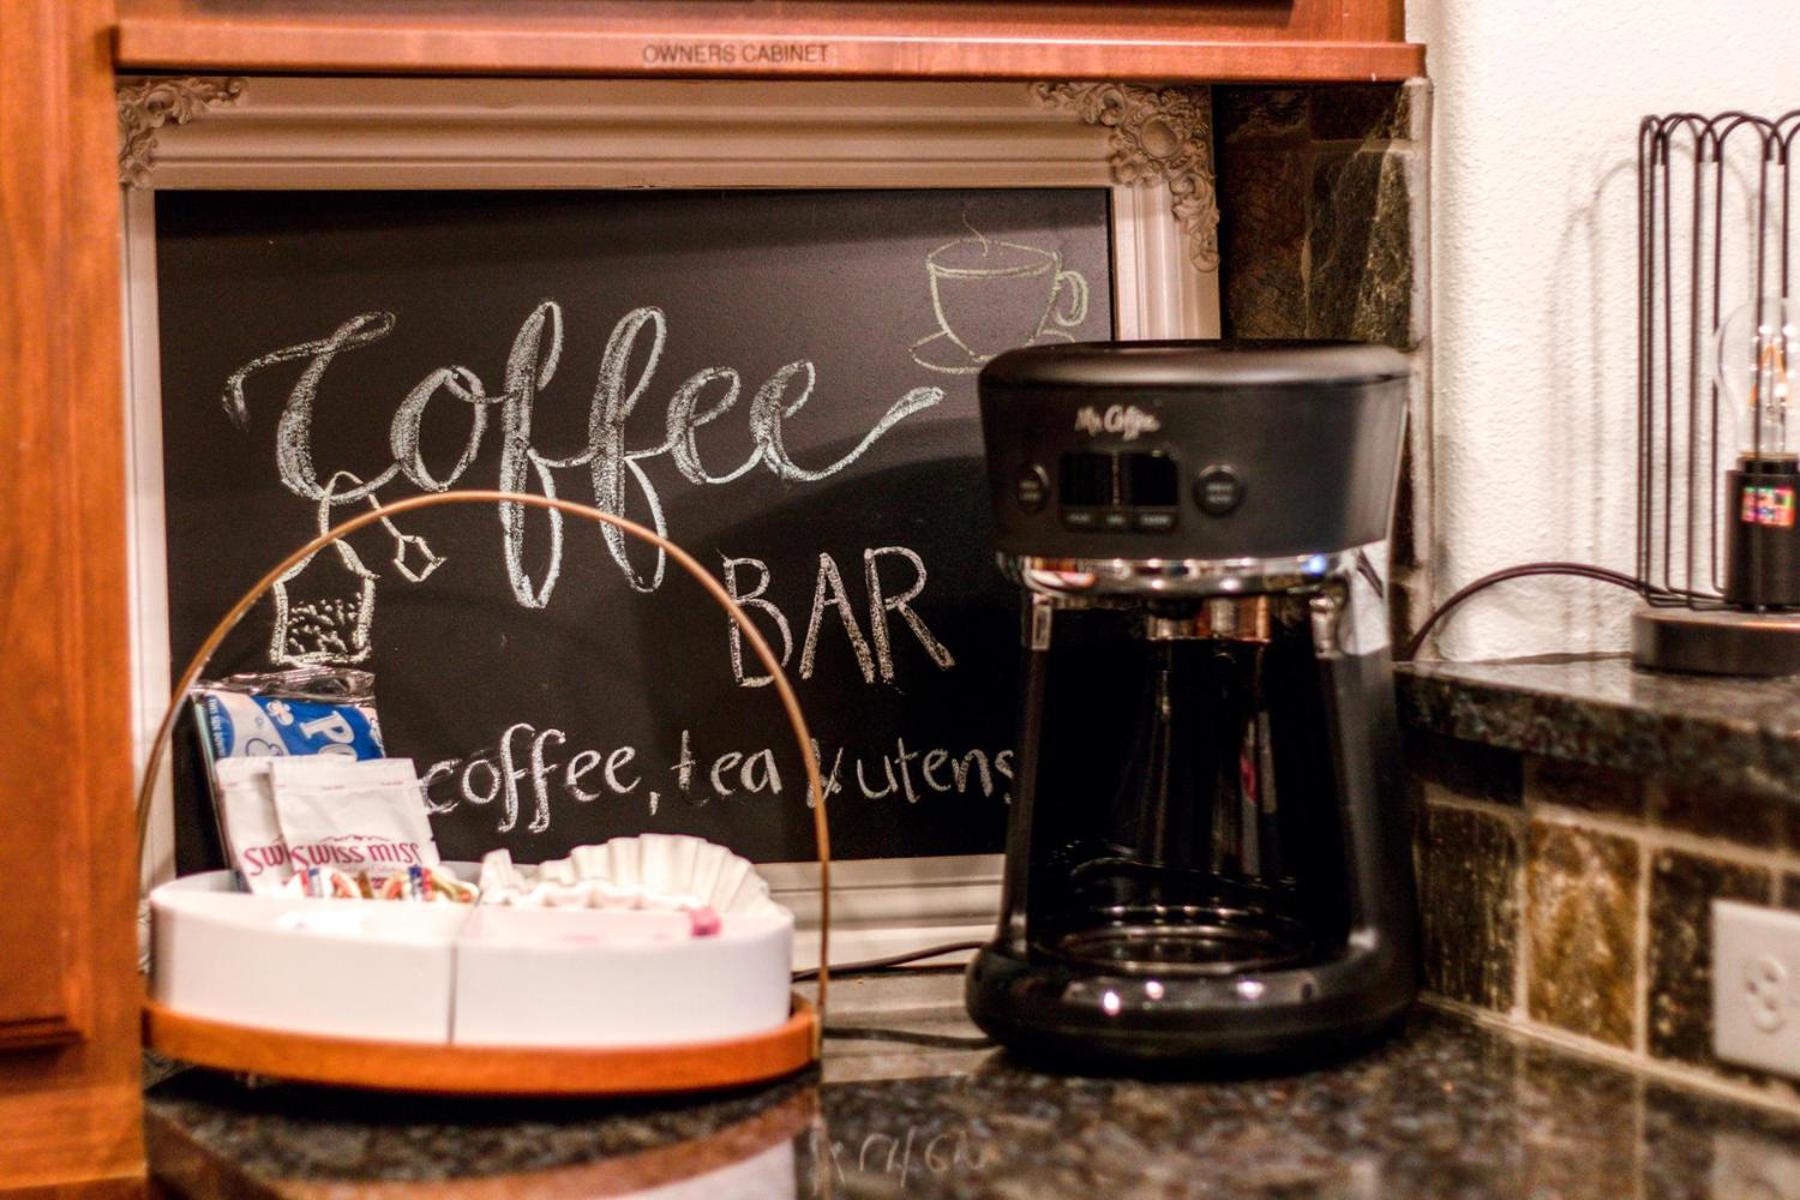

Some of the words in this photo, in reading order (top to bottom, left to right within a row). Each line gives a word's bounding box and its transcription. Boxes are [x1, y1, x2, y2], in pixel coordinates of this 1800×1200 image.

[642, 43, 736, 64] OWNERS
[742, 43, 829, 64] CABINET
[221, 299, 944, 609] Coffee
[715, 546, 956, 688] BAR
[419, 722, 658, 833] coffee,
[670, 729, 782, 797] tea
